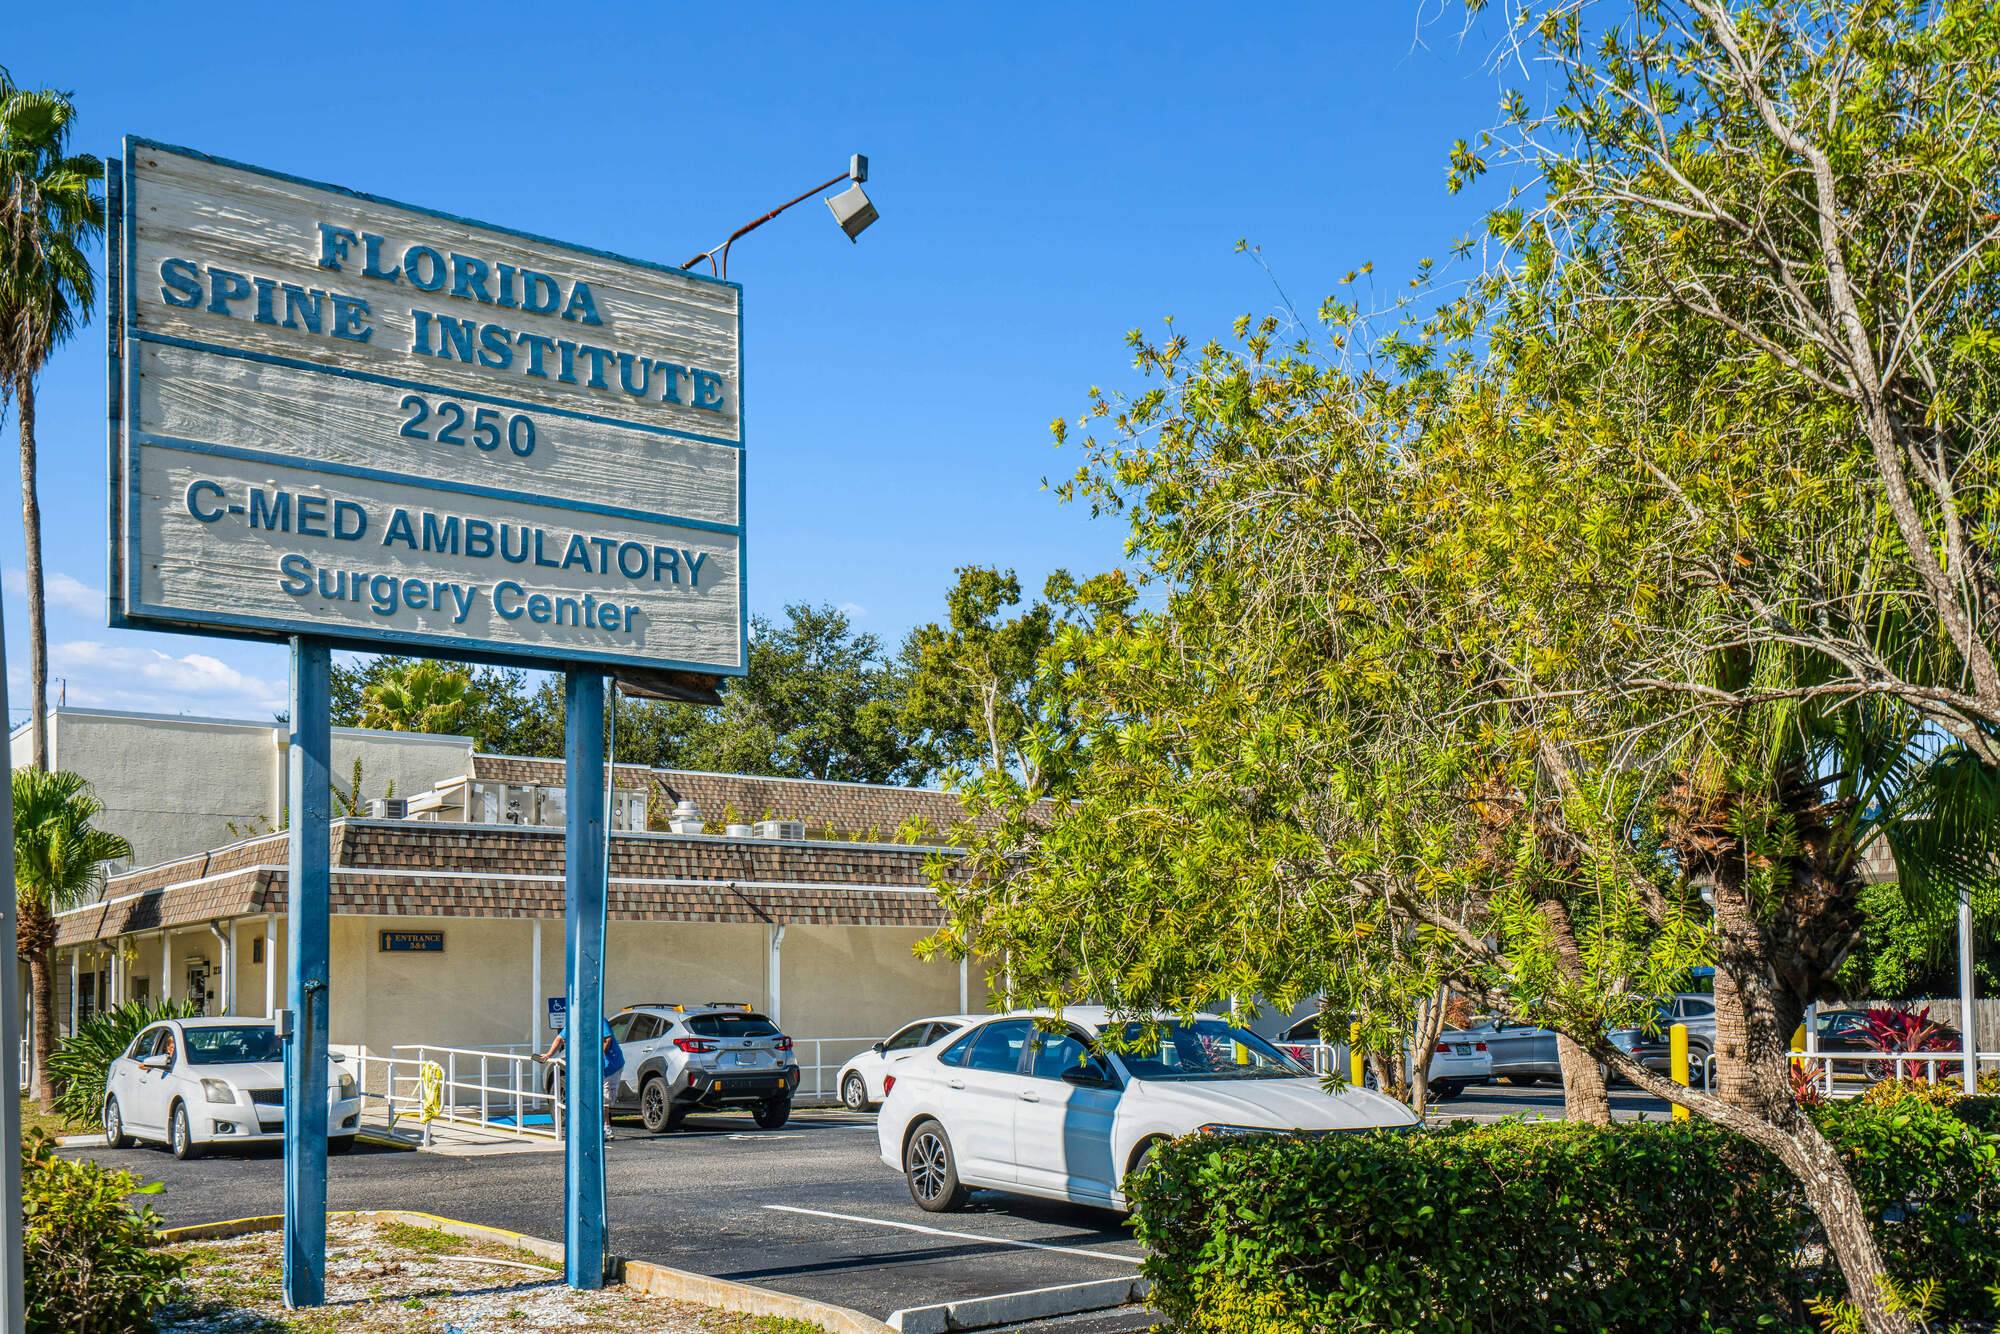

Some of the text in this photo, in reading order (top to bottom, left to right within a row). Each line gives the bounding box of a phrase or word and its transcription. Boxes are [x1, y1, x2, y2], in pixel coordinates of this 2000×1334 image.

[316, 222, 603, 327] FLORIDA
[159, 256, 725, 412] SPINE INSTITUTE
[399, 395, 537, 457] 2250
[186, 480, 708, 587] C-MED AMBULATORY
[279, 554, 640, 633] Surgery Center
[395, 934, 441, 942] ENTRANCE
